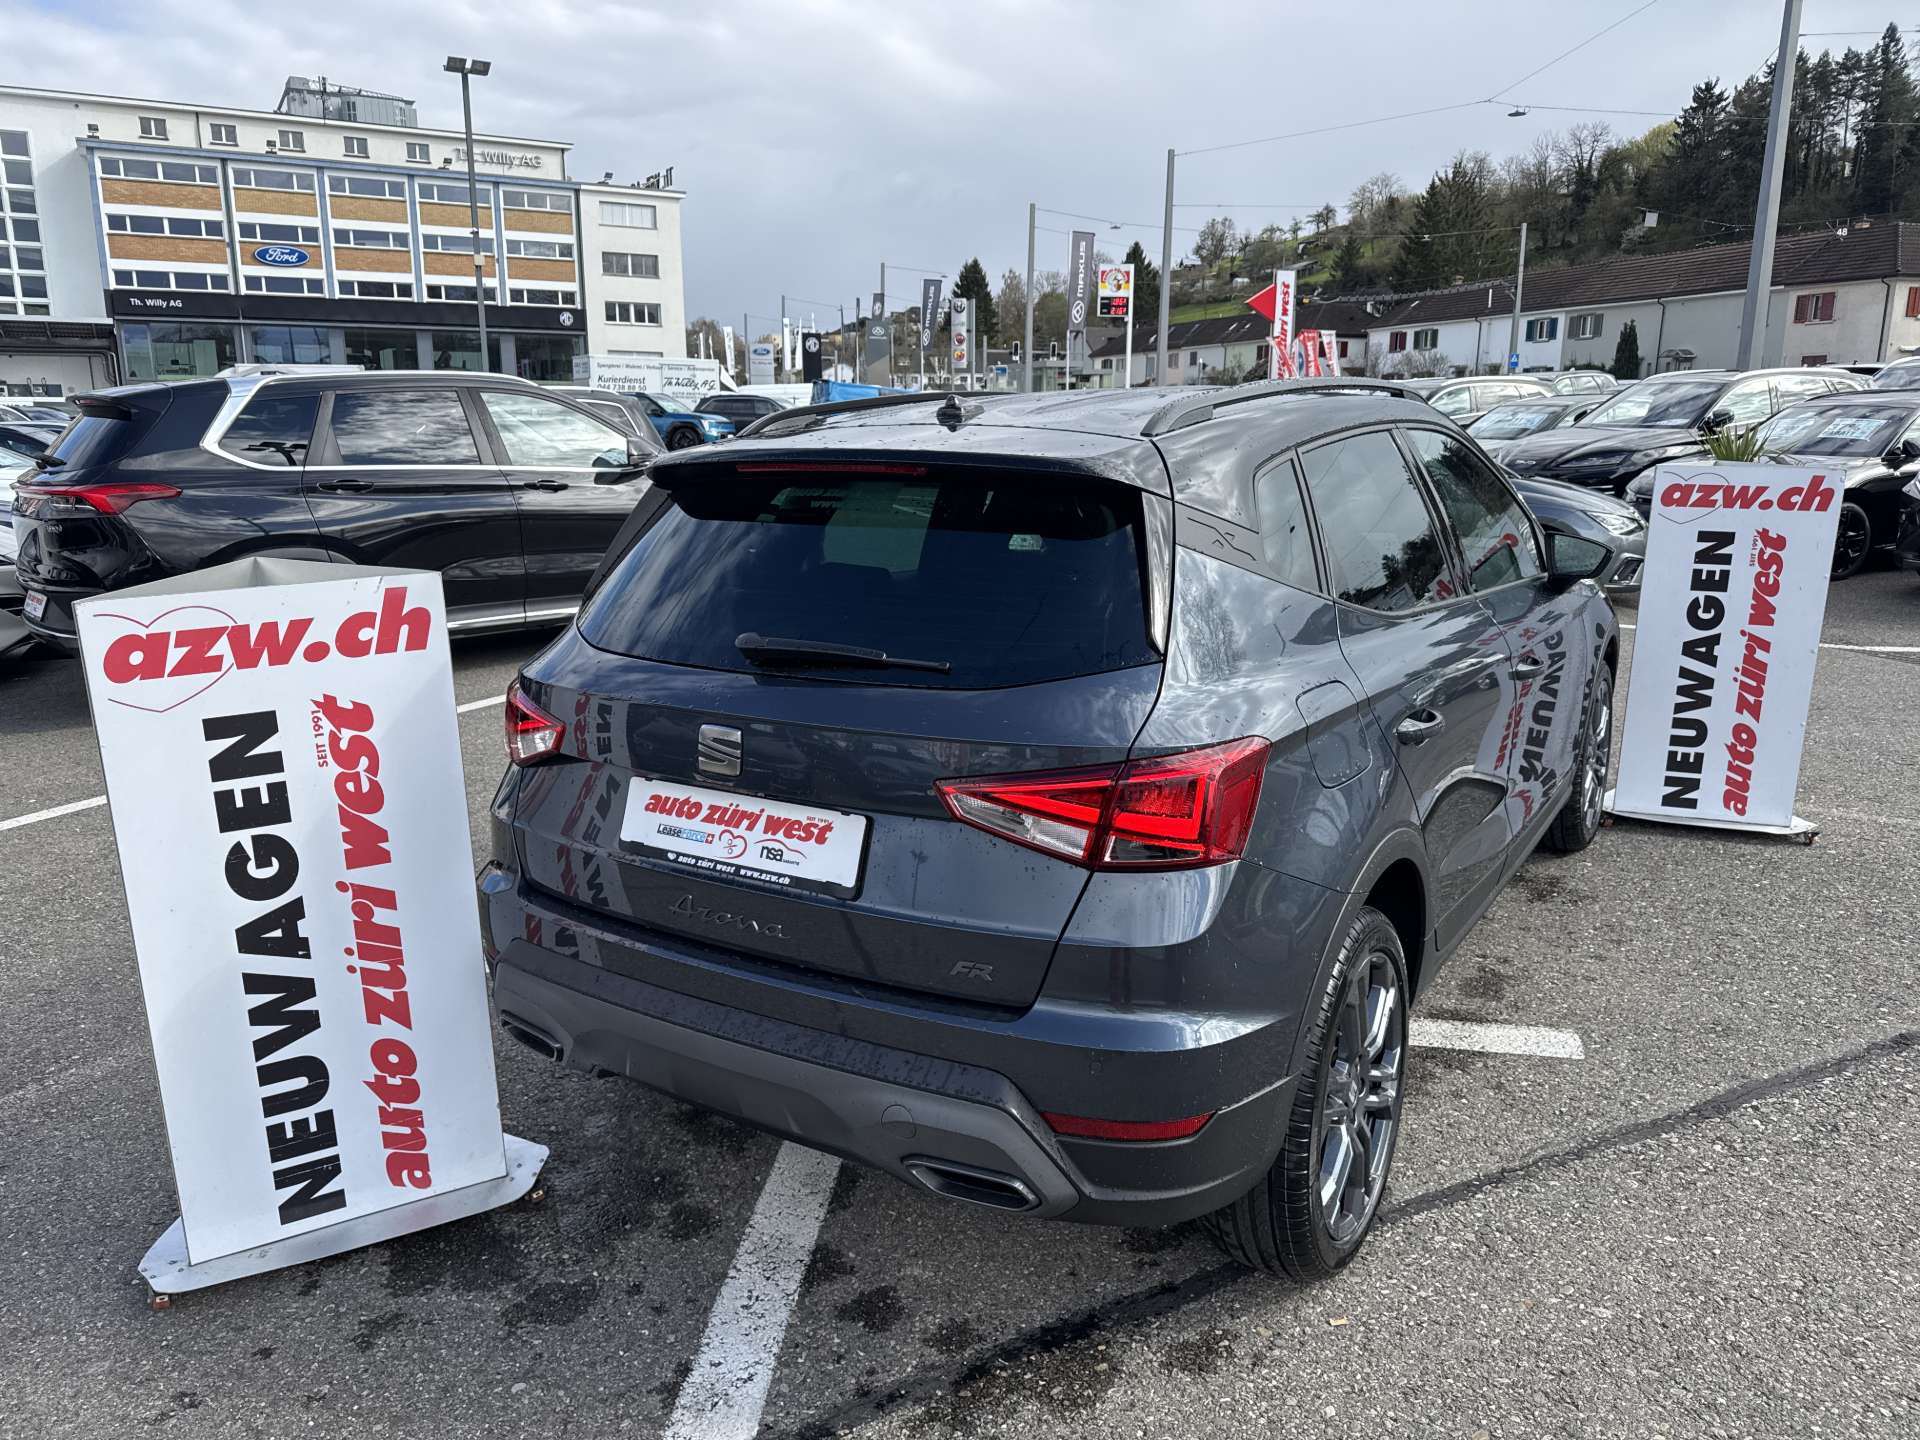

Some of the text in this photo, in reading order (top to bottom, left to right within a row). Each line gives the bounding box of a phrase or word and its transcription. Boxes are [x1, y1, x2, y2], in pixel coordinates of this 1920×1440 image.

[482, 150, 516, 169] Willy
[520, 154, 544, 168] AG
[265, 246, 299, 262] Ford
[145, 298, 167, 308] Willy
[169, 299, 183, 308] AG
[1281, 281, 1290, 316] west
[597, 375, 646, 385] Kurierdienst
[1660, 475, 1836, 513] azw.ch
[1749, 552, 1757, 567] SEIT
[103, 587, 431, 684] azw.ch
[1661, 529, 1736, 809] NEUWAGEN
[1723, 527, 1788, 817] auto züri west
[310, 709, 329, 768] SEIT 1991
[644, 794, 835, 845] auto züri west
[677, 855, 696, 866] auto
[716, 863, 736, 873] west
[739, 867, 791, 885] www.azw.ch
[760, 845, 783, 862] nsa
[668, 895, 791, 939] Arona
[310, 693, 432, 1190] auto züri west
[201, 710, 348, 1226] NEUWAGEN
[950, 960, 993, 982] FR
